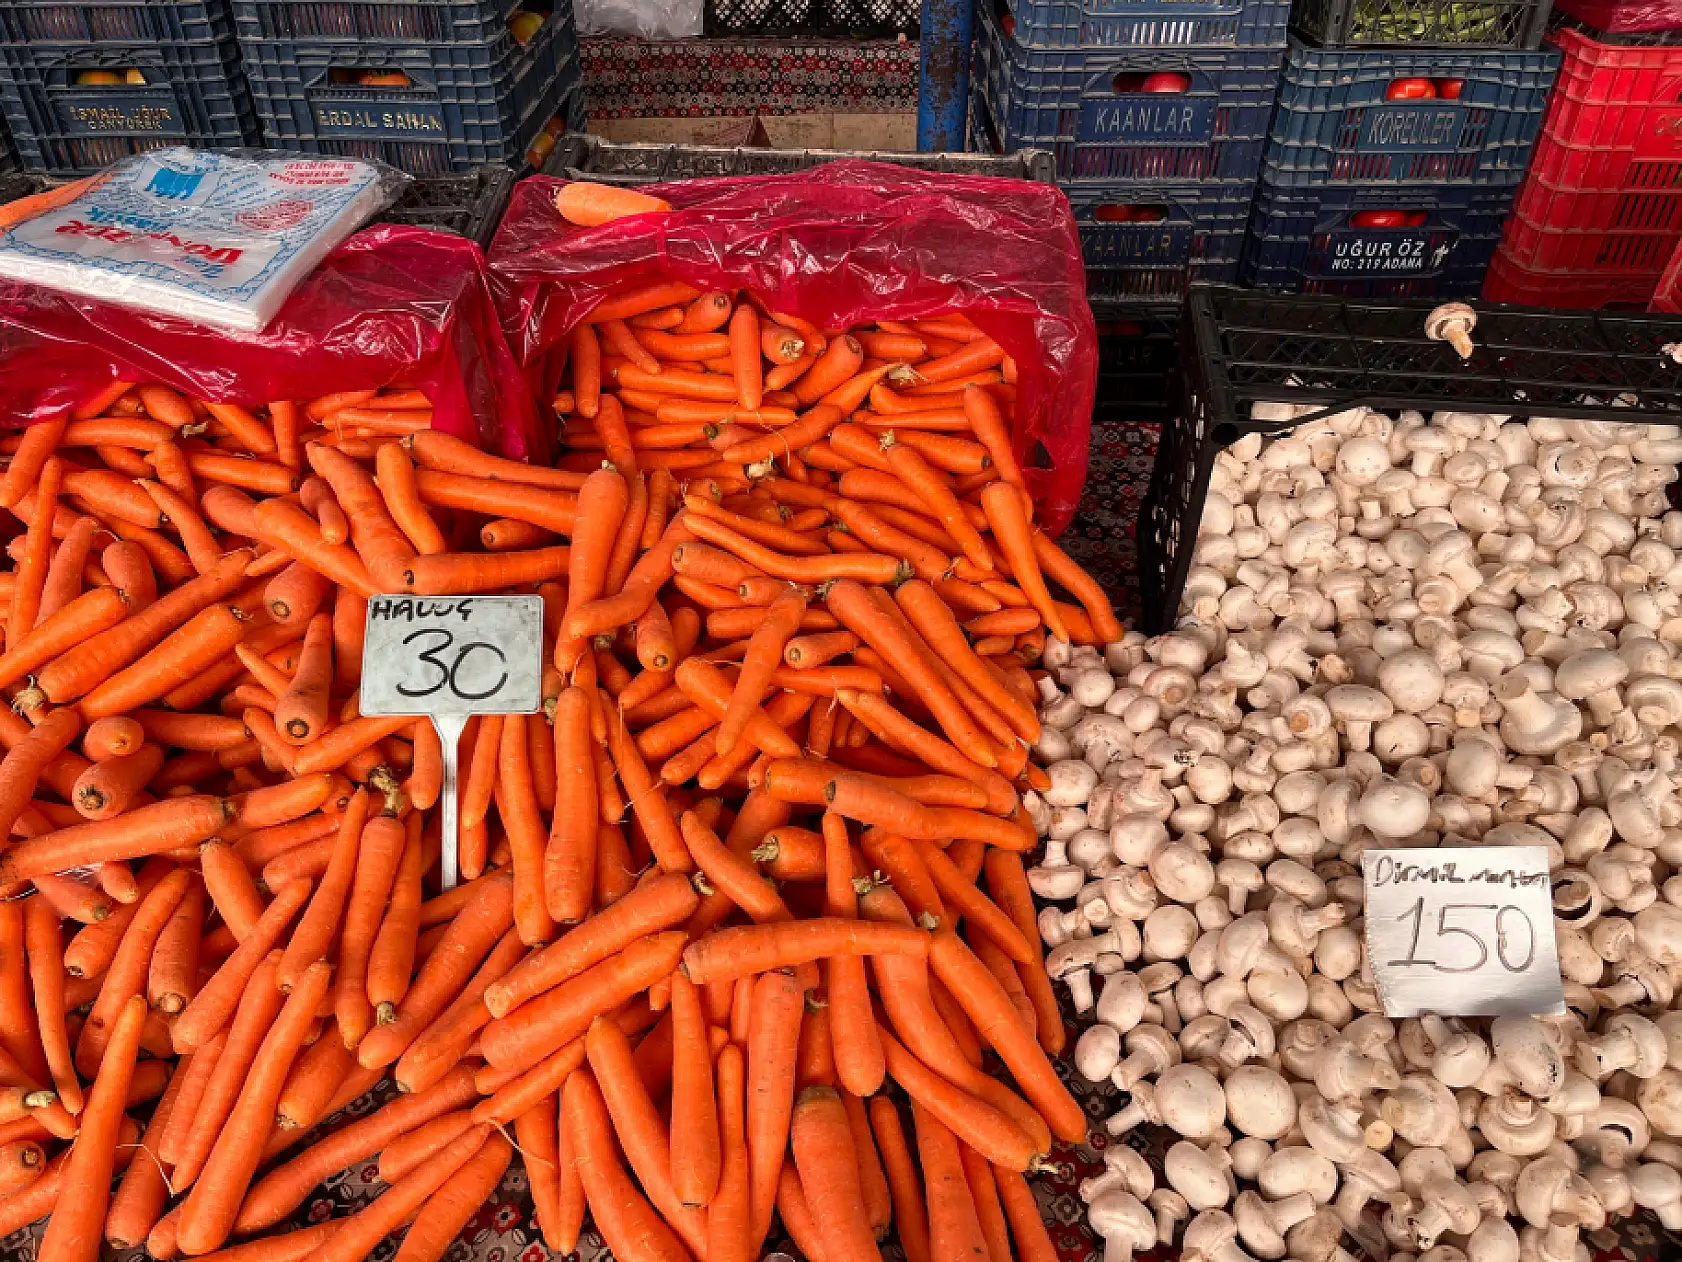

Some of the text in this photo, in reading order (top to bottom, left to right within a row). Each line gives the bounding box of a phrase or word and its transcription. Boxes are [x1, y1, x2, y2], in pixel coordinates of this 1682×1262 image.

[317, 111, 378, 127] ERDAL
[1095, 105, 1194, 133] KAANLAR
[1335, 239, 1425, 257] UĞUR ÖZ
[395, 628, 508, 699] 30
[1387, 896, 1535, 973] 150
